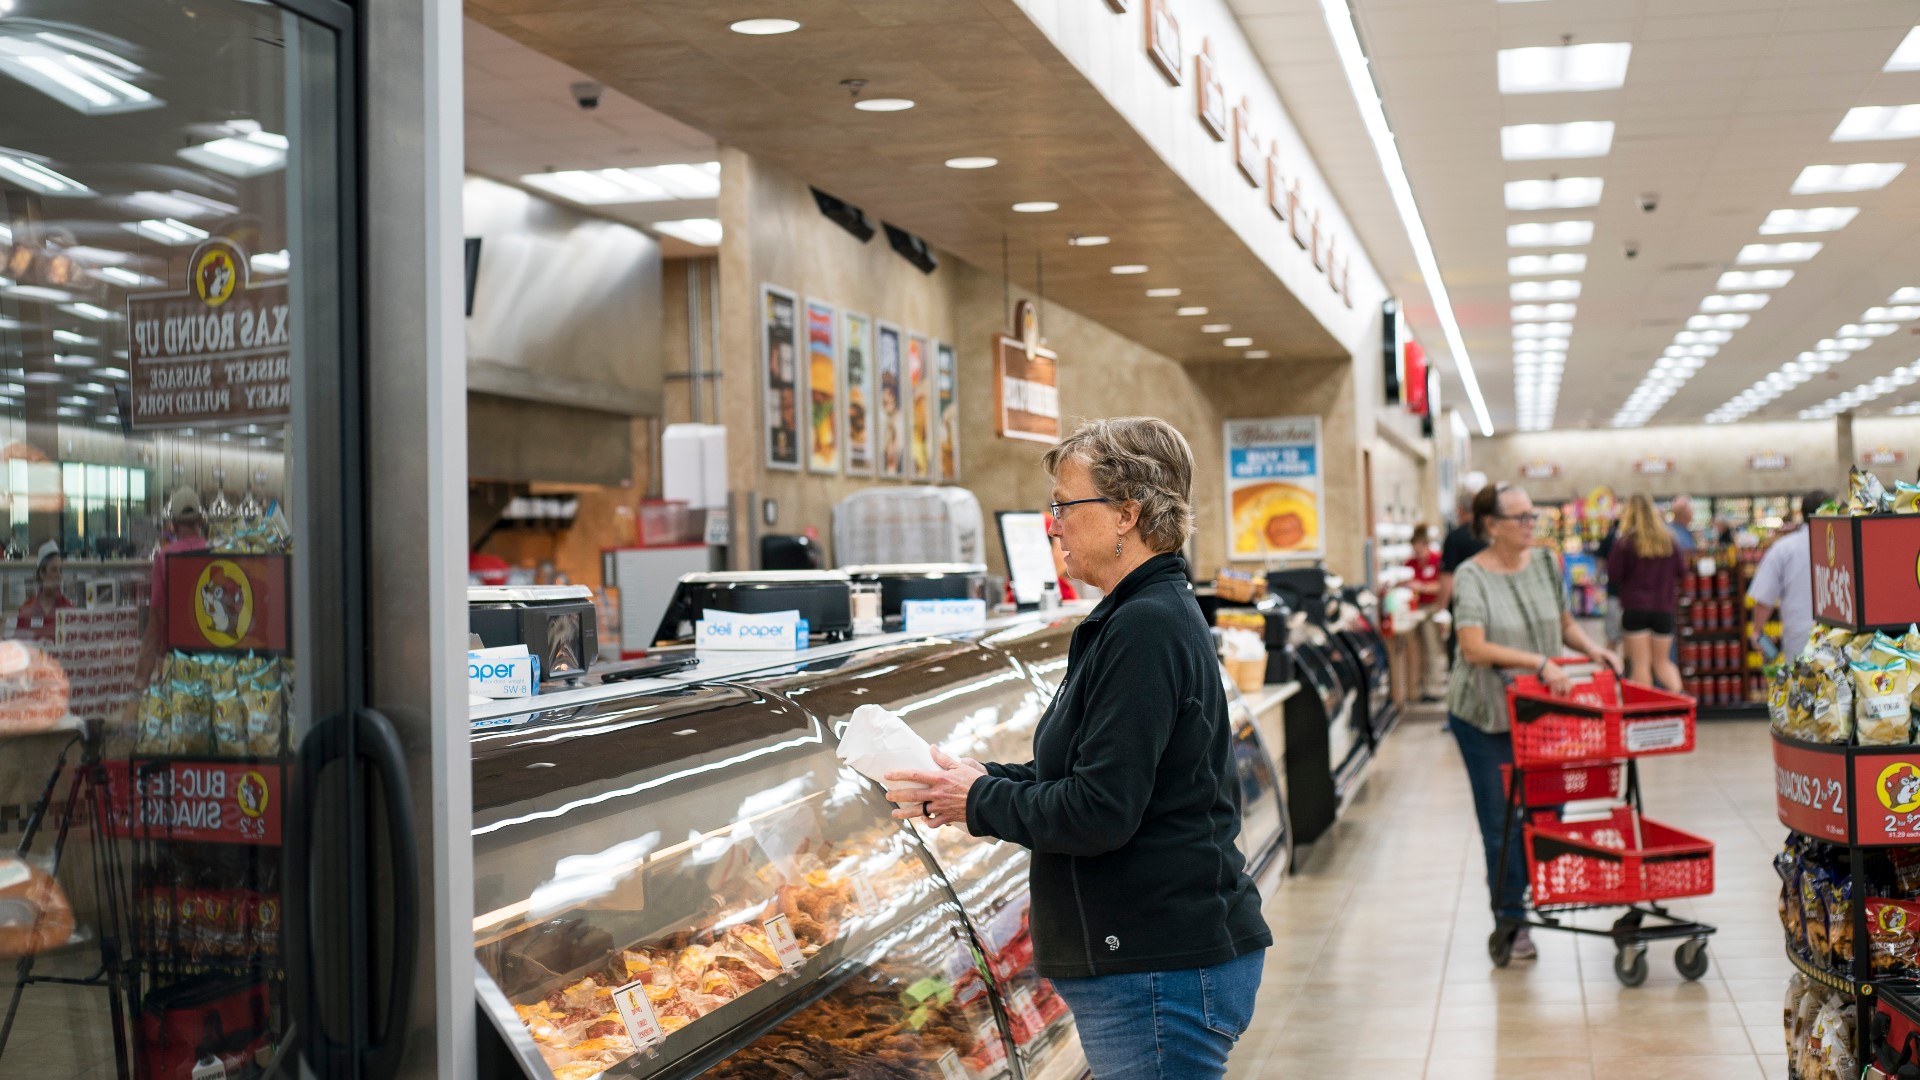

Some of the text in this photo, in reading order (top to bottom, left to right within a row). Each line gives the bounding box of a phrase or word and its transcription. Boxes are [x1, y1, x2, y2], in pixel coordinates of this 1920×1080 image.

[706, 622, 784, 638] deli paper
[503, 685, 527, 694] SW-8
[1812, 777, 1823, 810] 2
[1884, 815, 1898, 832] 2
